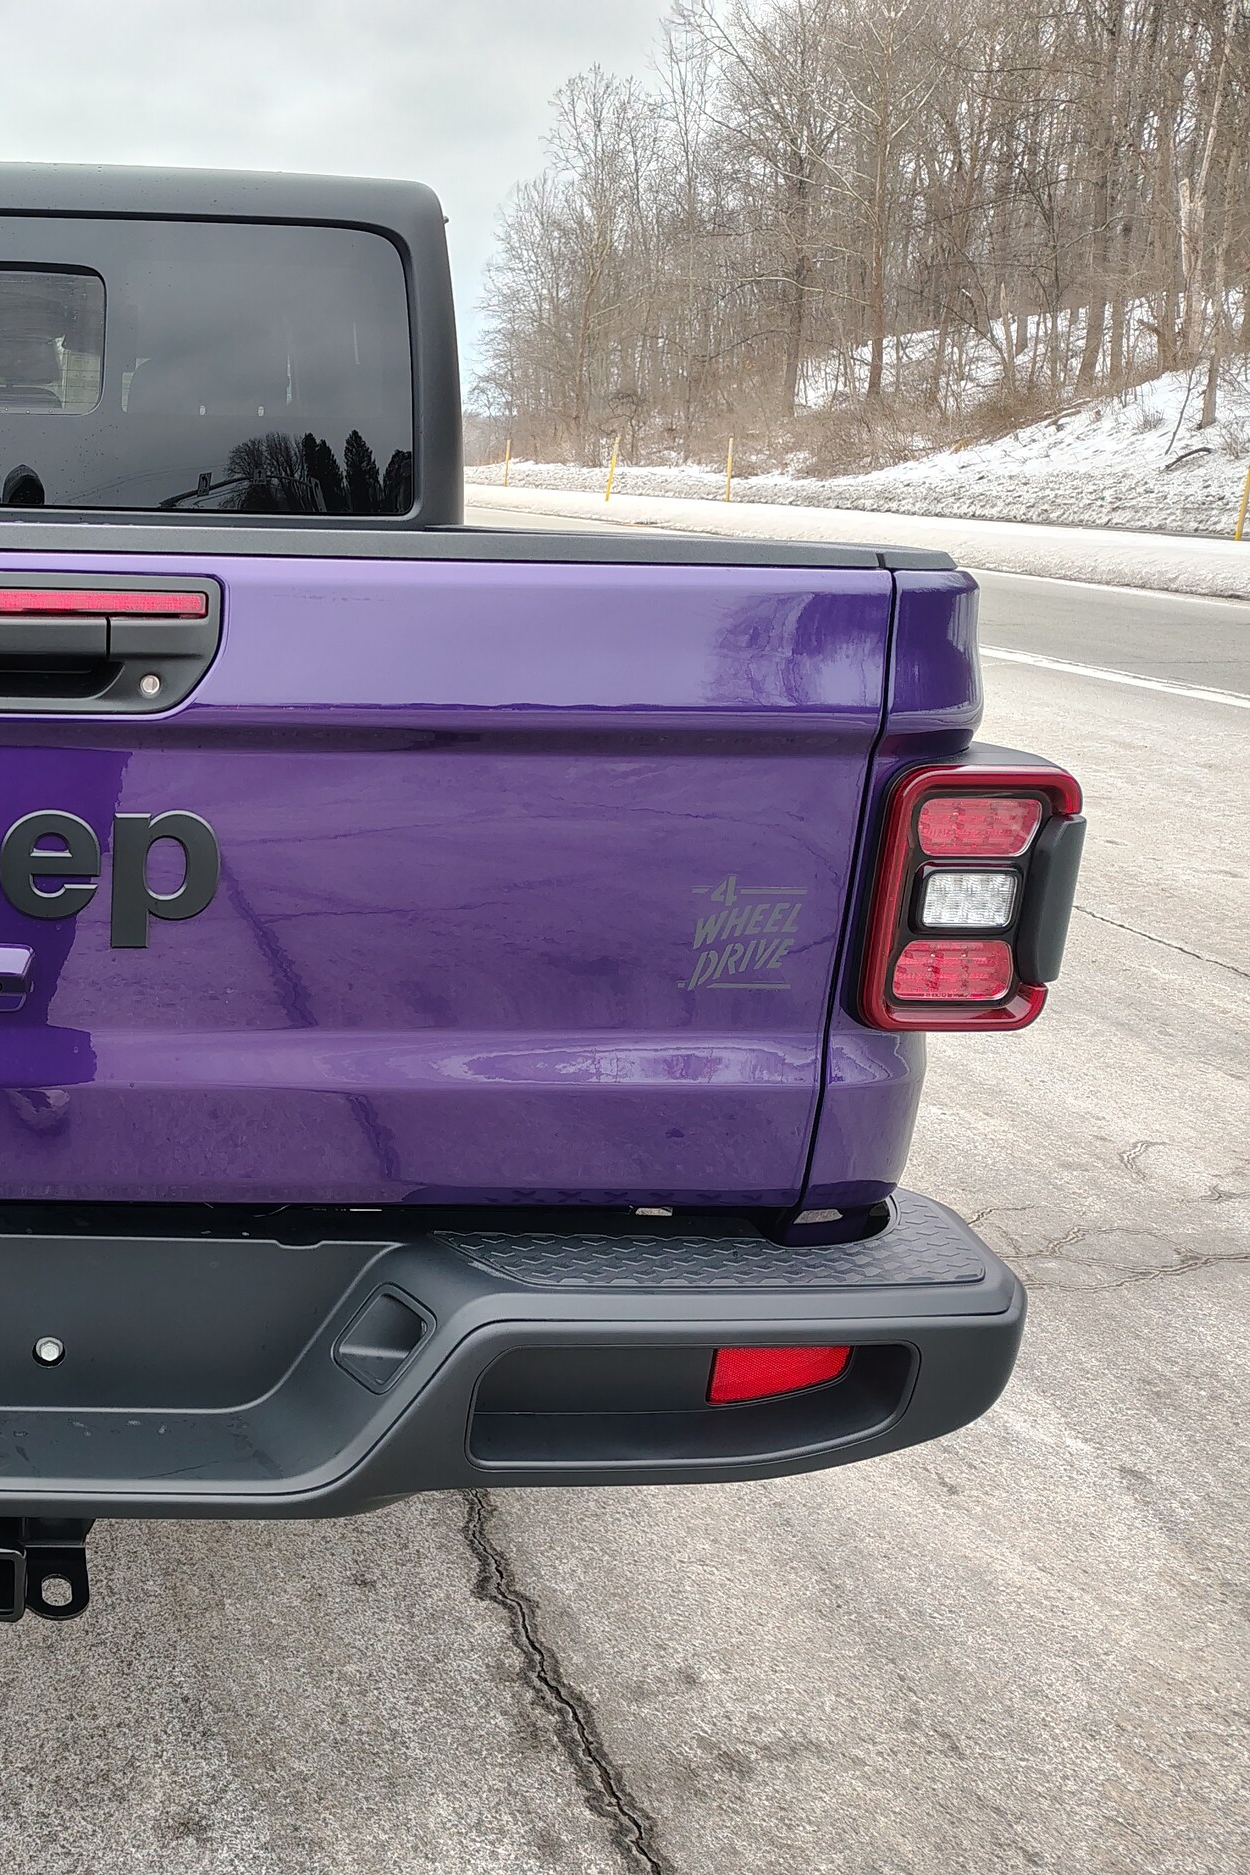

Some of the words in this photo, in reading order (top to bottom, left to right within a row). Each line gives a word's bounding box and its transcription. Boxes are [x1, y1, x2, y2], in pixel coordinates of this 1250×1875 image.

[711, 875, 738, 907] 4
[693, 902, 802, 950] WHEEL
[687, 939, 795, 991] DRIVE
